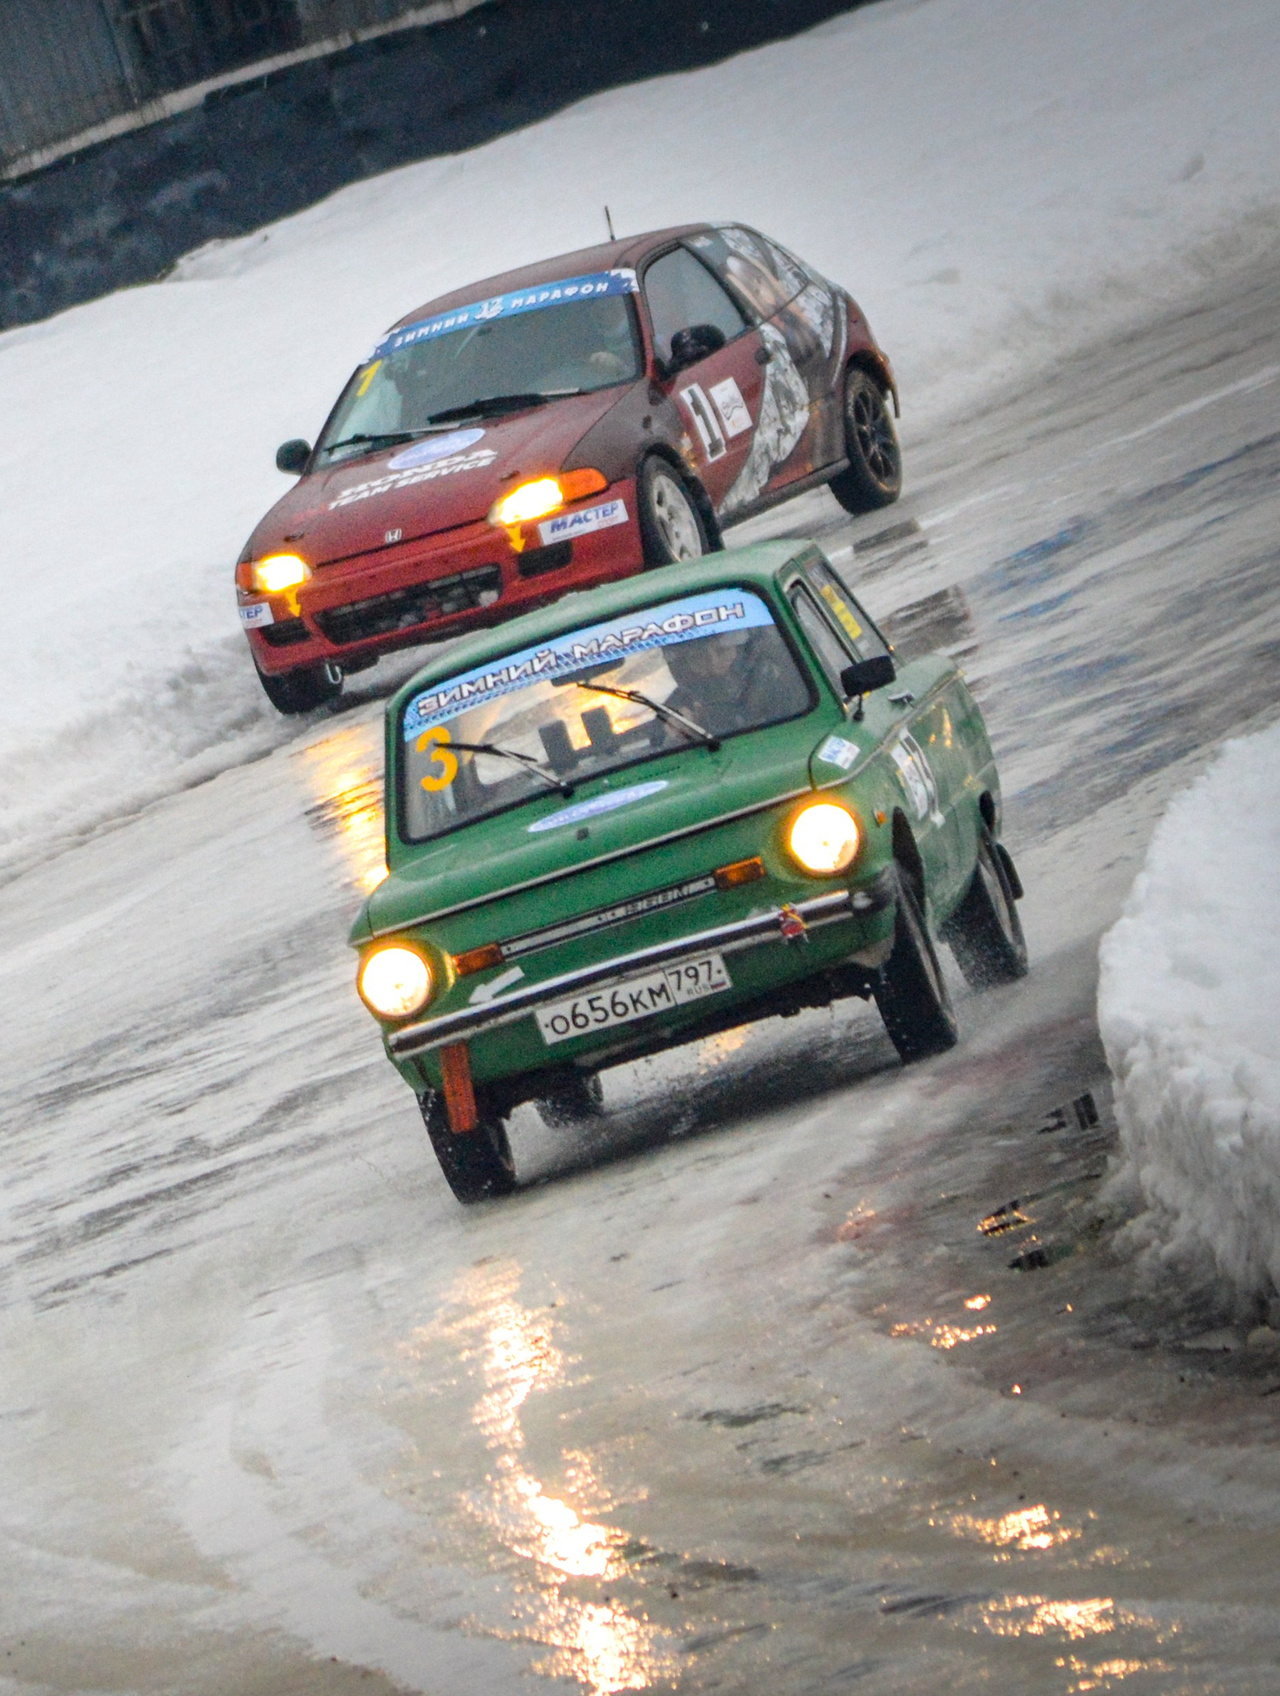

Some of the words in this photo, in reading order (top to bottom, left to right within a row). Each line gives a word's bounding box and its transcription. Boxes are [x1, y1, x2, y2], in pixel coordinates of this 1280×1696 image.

[394, 313, 469, 347] ЗИМНИЙ
[511, 282, 609, 308] МАРАФОН
[356, 359, 382, 397] 1
[687, 388, 722, 458] 1
[329, 484, 392, 510] TEAM
[395, 457, 498, 489] SERVICE
[340, 449, 498, 498] HONDA
[550, 503, 618, 533] МАСТЕР
[418, 650, 557, 717] ЗИМНИЙ
[573, 602, 745, 660] МАРАФОН
[416, 726, 459, 792] 3
[668, 960, 713, 991] 797
